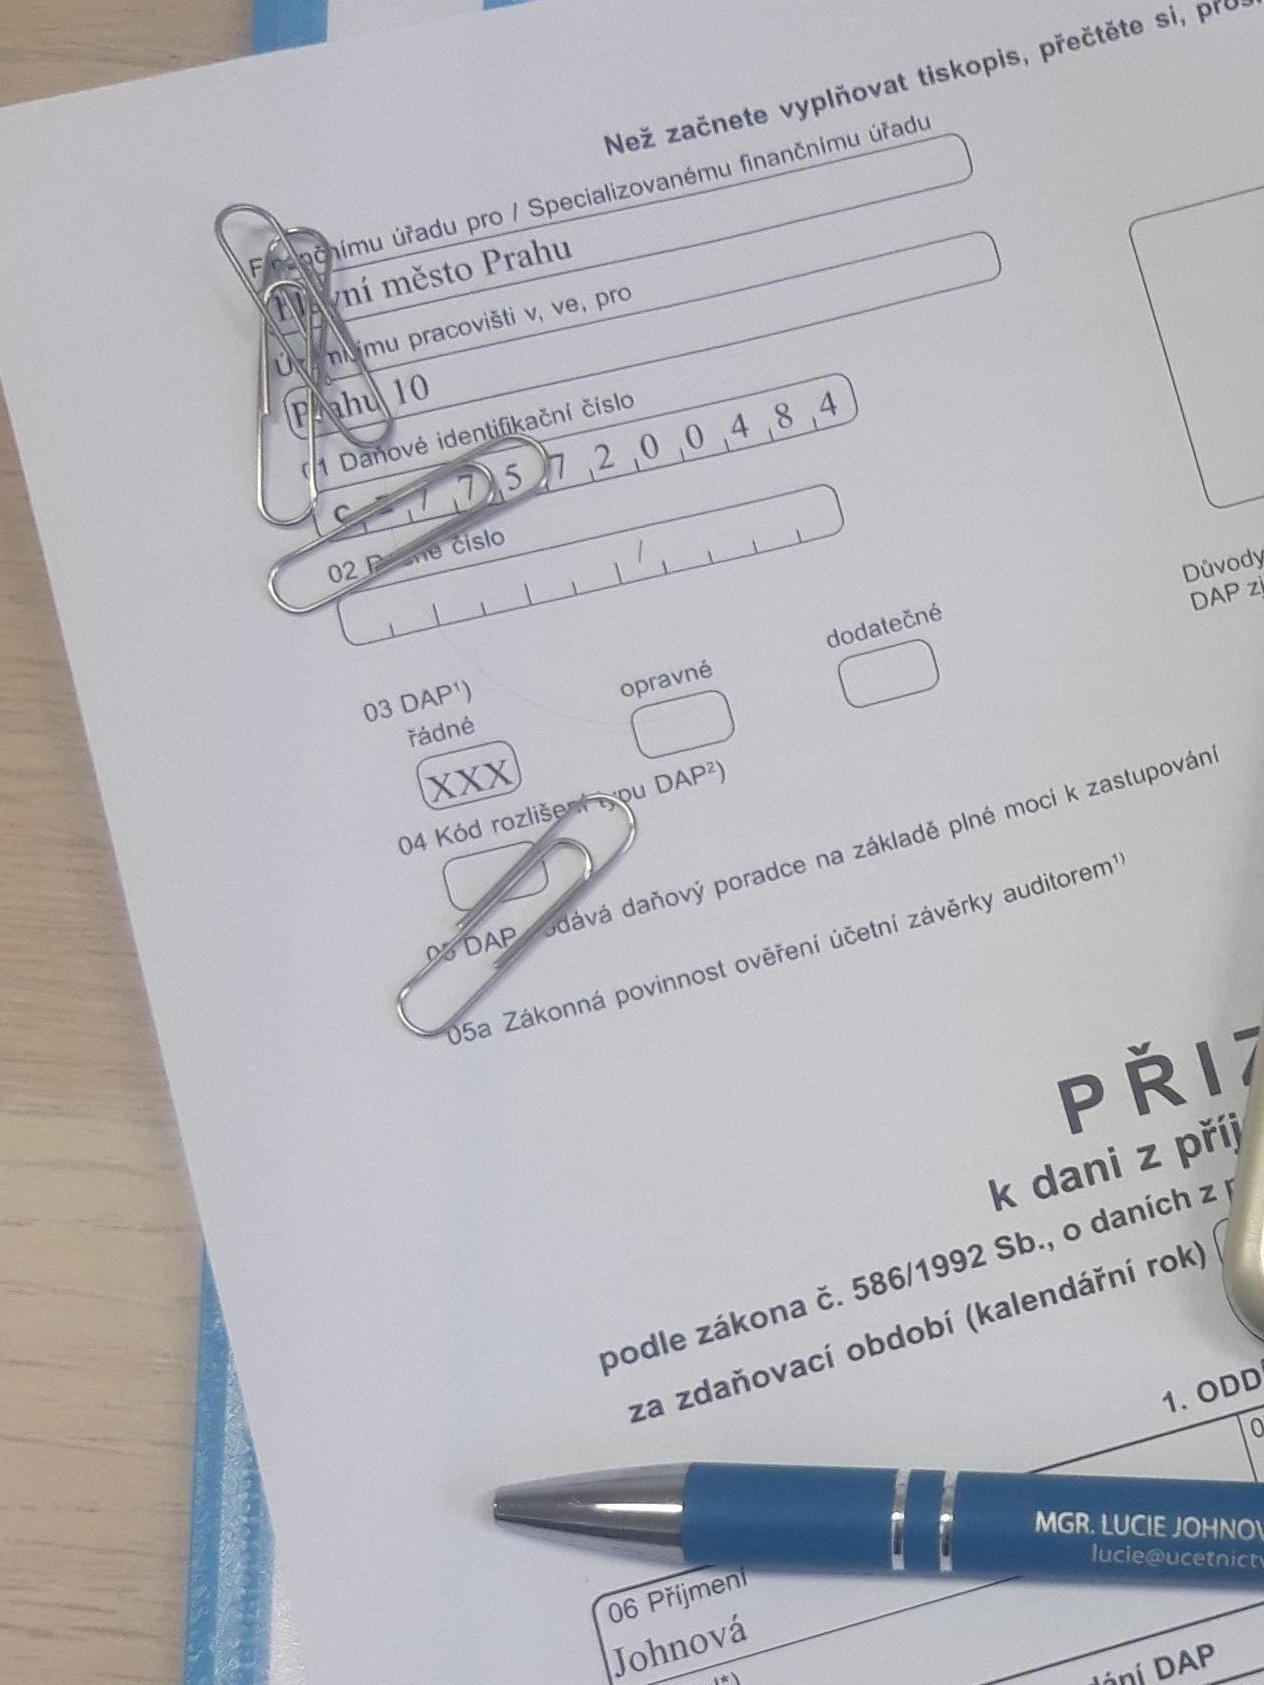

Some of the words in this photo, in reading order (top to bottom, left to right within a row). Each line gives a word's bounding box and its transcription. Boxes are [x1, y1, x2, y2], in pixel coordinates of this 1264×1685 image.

[603, 127, 656, 156] Než
[665, 108, 769, 144] začnete
[779, 71, 909, 122] vyplňovat
[918, 48, 1029, 87] tiskopis,
[1039, 18, 1144, 62] přečtěte
[1154, 5, 1186, 29] si,
[393, 219, 457, 248] úřadu
[466, 210, 504, 235] pro
[528, 161, 731, 219] Specializovanému
[740, 130, 861, 174] finančnímu
[869, 113, 932, 143] úřadu
[382, 264, 474, 299] město
[480, 238, 573, 277] Prahu
[409, 306, 515, 350] pracovišti
[525, 306, 544, 325] v,
[552, 295, 586, 315] ve,
[595, 285, 632, 311] pro
[291, 391, 380, 428] Pahu
[393, 374, 430, 404] 10
[438, 403, 572, 451] identifikační
[582, 392, 634, 418] číslo
[328, 561, 357, 583] 02
[452, 530, 505, 555] číslo
[1182, 549, 1264, 583] Důvody
[1190, 582, 1240, 611] DAP
[827, 602, 943, 648] dodatečné
[620, 659, 714, 699] opravné
[363, 700, 393, 723] 03
[407, 715, 475, 748] řádné
[398, 831, 428, 856] 04
[435, 818, 483, 849] Kód
[464, 927, 517, 956] DAP
[622, 883, 705, 920] daňový
[714, 857, 806, 899] poradce
[815, 848, 845, 870] na
[853, 821, 940, 861] základě
[948, 806, 996, 839] plné
[1005, 789, 1057, 821] moci
[1065, 782, 1079, 803] k
[1087, 743, 1221, 798] zastupování
[447, 1021, 492, 1045] 05a
[503, 990, 607, 1033] Zákonná
[616, 960, 727, 1007] povinnost
[735, 934, 821, 974] ověření
[830, 915, 899, 951] účetní
[907, 892, 994, 930] závěrky
[988, 1178, 1018, 1212] k
[1032, 1146, 1123, 1200] dani
[1136, 1143, 1162, 1171] z
[600, 1329, 687, 1376] podle
[696, 1297, 808, 1346] zákona
[816, 1285, 844, 1311] č.
[852, 1243, 987, 1303] 586/1992
[994, 1232, 1055, 1260] Sb.,
[1063, 1223, 1081, 1242] o
[1090, 1189, 1191, 1234] daních
[1199, 1184, 1217, 1205] z
[629, 1397, 665, 1424] za
[675, 1343, 835, 1412] zdaňovací
[847, 1310, 955, 1363] období
[967, 1261, 1136, 1333] (kalendářní
[1147, 1240, 1207, 1278] rok)
[1162, 1390, 1188, 1413] 1.
[1034, 1510, 1095, 1536] MGR.
[1100, 1512, 1166, 1538] LUCIE
[608, 1598, 639, 1623] 06
[647, 1565, 748, 1613] Příjmení
[611, 1613, 748, 1678] Johnová
[1153, 1642, 1216, 1681] DAP
